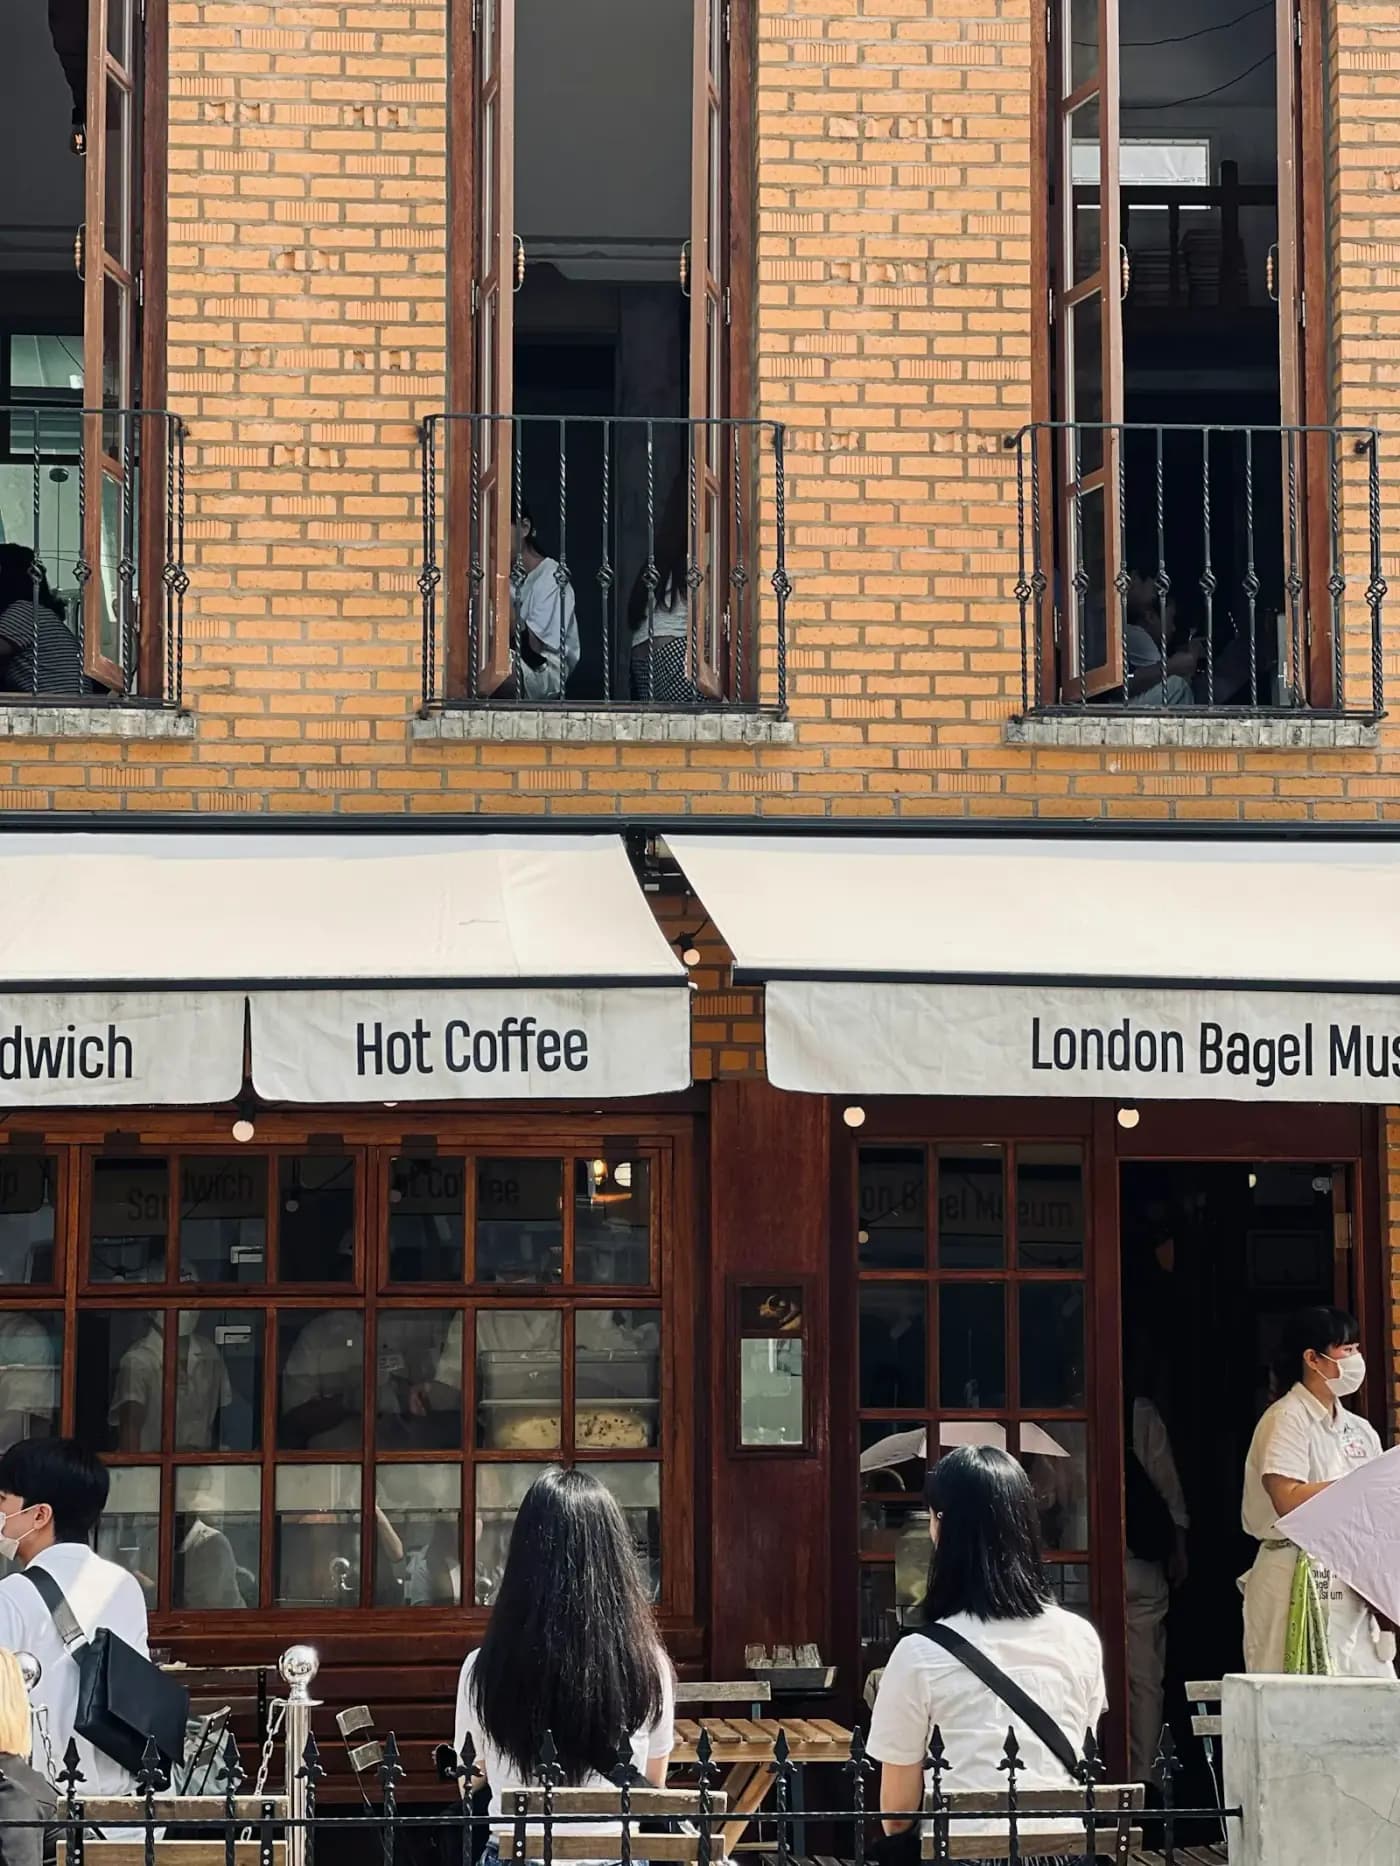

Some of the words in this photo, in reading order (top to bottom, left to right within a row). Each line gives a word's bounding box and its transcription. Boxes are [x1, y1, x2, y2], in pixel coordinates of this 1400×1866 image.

[0, 1025, 133, 1081] dwich
[357, 1018, 434, 1076] Hot
[445, 1016, 588, 1073] Coffee
[1032, 1016, 1184, 1073] London
[1200, 1022, 1313, 1087] Bagel
